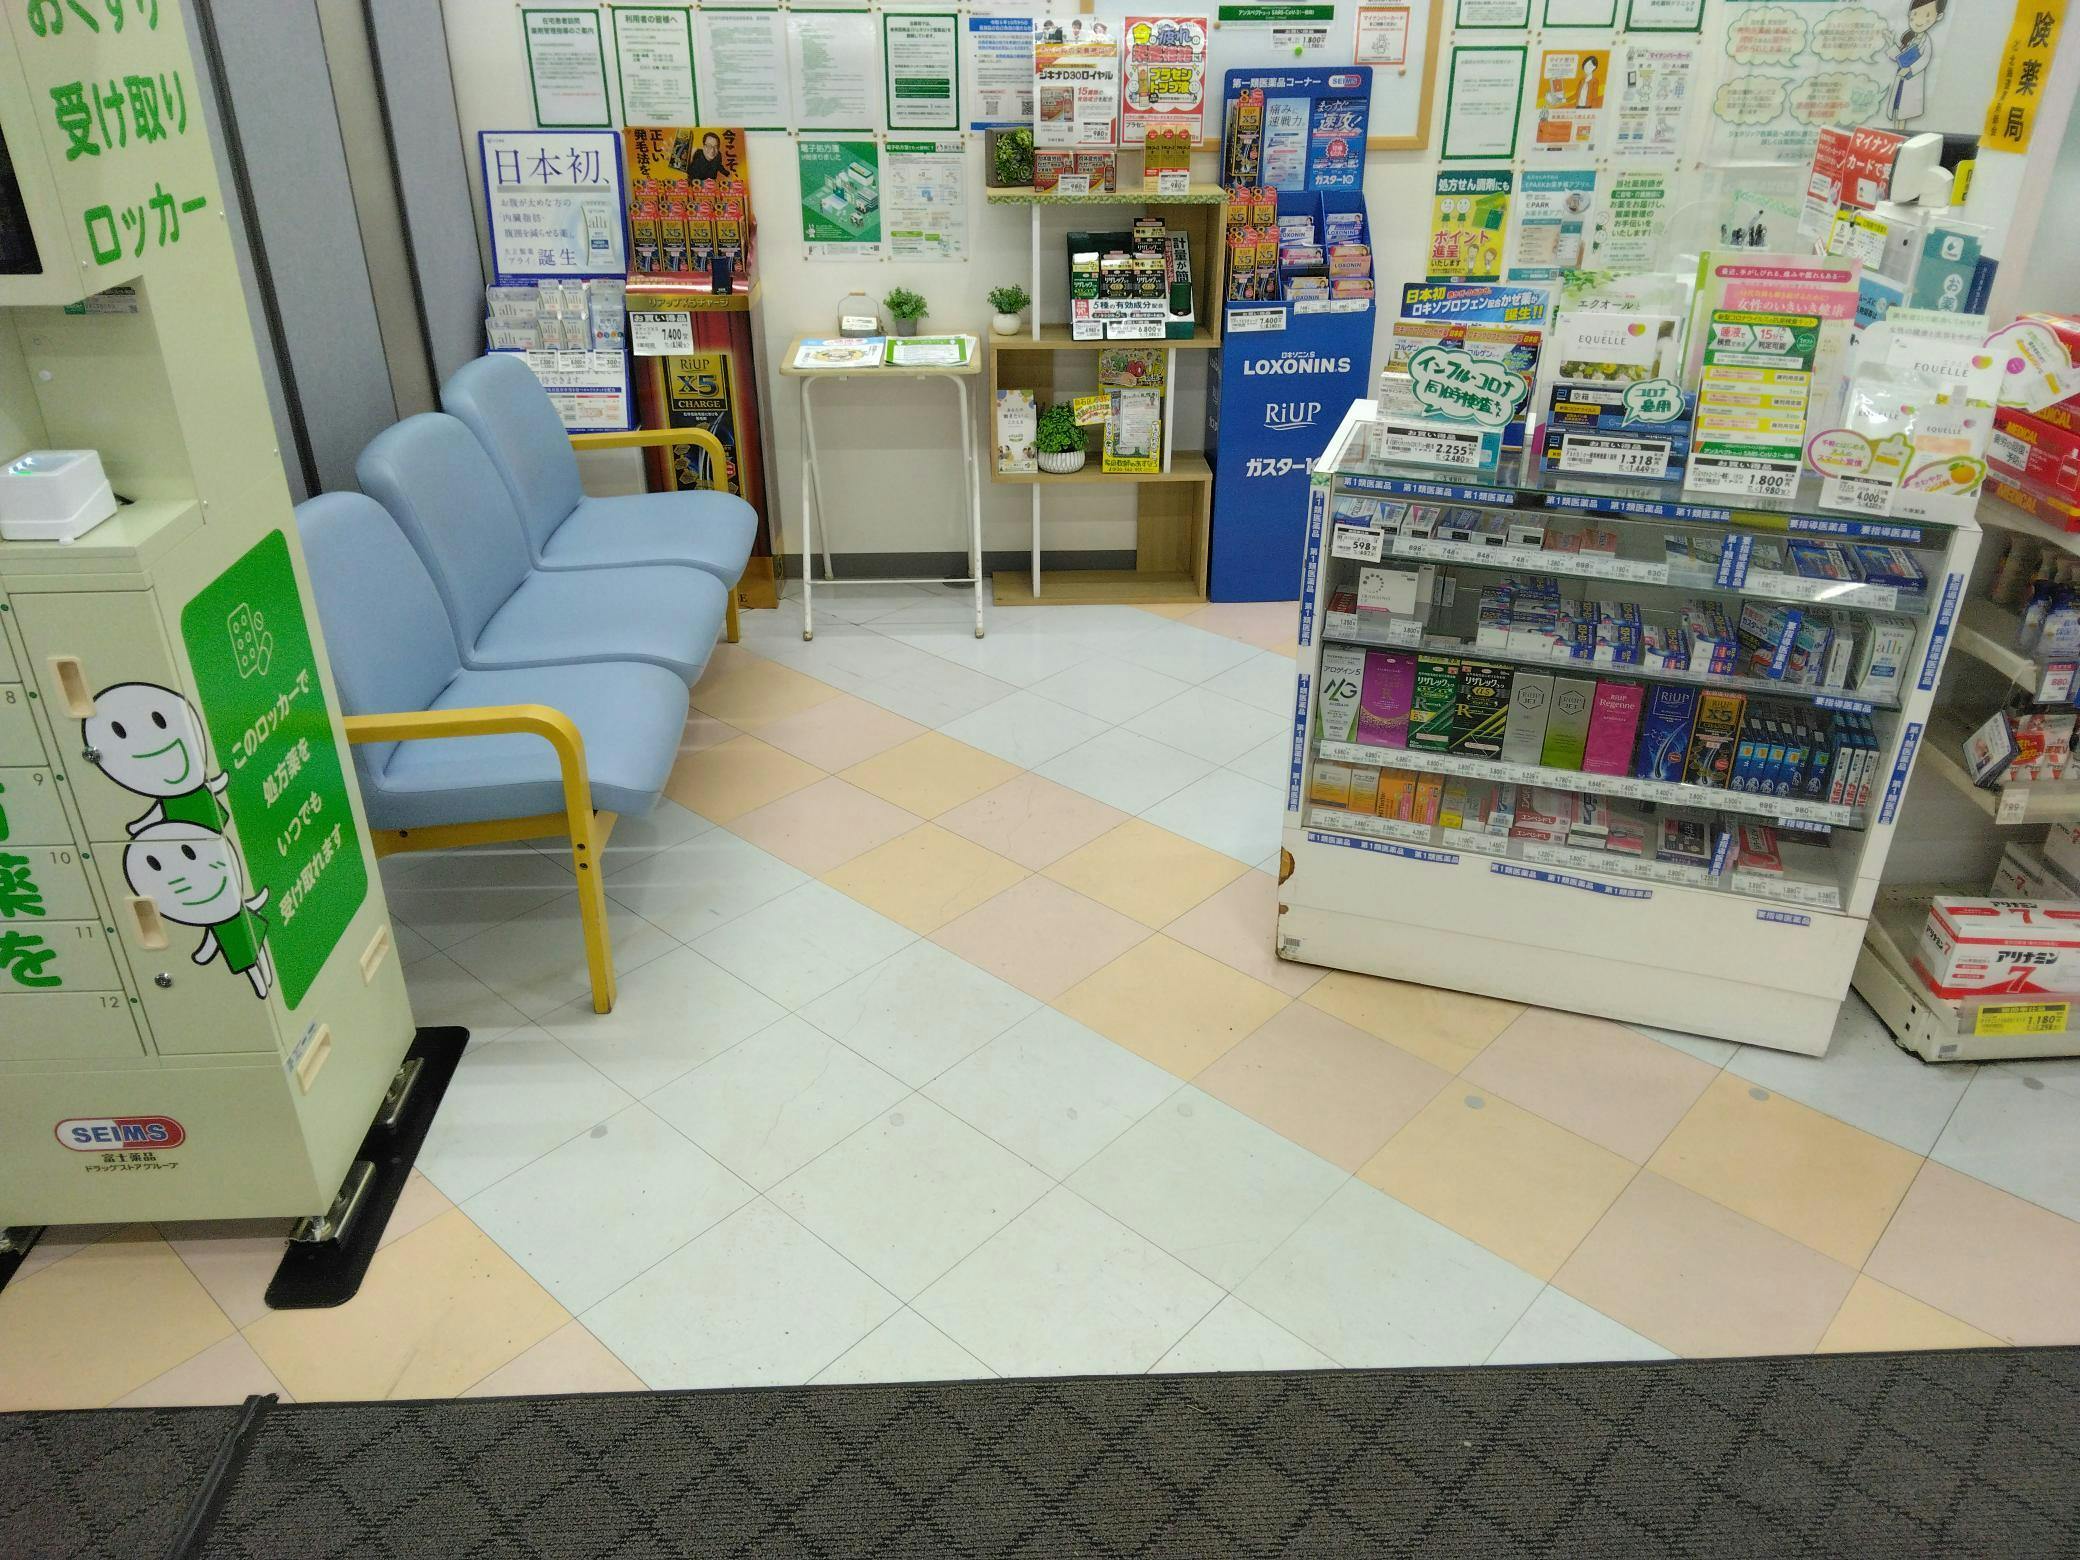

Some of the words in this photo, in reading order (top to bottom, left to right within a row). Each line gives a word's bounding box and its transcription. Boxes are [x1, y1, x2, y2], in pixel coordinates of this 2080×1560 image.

[1232, 77, 1321, 88] 第一類医薬品コーナー
[50, 71, 187, 161] 受け取り
[649, 129, 665, 163] 正しい
[494, 147, 610, 185] 日本初、
[1438, 177, 1510, 192] 処方せん調剤にも
[84, 182, 207, 265] ロッカー
[1614, 219, 1651, 227] お手伝いを
[637, 228, 653, 239] X5
[665, 228, 682, 239] X5
[692, 228, 709, 239] X5
[720, 228, 737, 239] X5
[1434, 229, 1489, 245] ポイント
[538, 247, 577, 266] 誕生
[1432, 244, 1459, 259] 進呈
[1431, 259, 1461, 267] いたします
[1405, 287, 1447, 304] 日本初
[1578, 334, 1628, 346] EQUELLE
[680, 359, 711, 370] RiUP
[677, 374, 720, 397] X5
[1635, 388, 1669, 397] コロナ
[678, 400, 721, 408] CHARGE
[1265, 402, 1322, 424] RiUP
[1926, 425, 1962, 435] EQUELLE
[2005, 421, 2038, 445] MEDICAL
[1343, 477, 1393, 491] 第1類医薬品
[1402, 482, 1453, 498] 第1類医薬品
[1463, 490, 1515, 505] 第1類医薬品
[1545, 492, 1598, 509] 第1類医薬品
[1610, 501, 1663, 515] 第1類医薬品
[1675, 507, 1731, 521] 第1類医薬品
[1352, 541, 1371, 551] 598
[6, 690, 17, 704] 8
[1661, 691, 1691, 702] RiUP
[1599, 698, 1636, 710] Regenne
[231, 668, 311, 770] このロッカーで
[32, 772, 44, 787] 9
[262, 736, 312, 809] 処方薬を
[277, 790, 323, 858] いつでも
[50, 851, 71, 865] 10
[279, 822, 343, 926] 受け取れます
[75, 926, 94, 939] 11
[1996, 950, 2059, 965] アリナミン
[2006, 965, 2038, 994] 7
[99, 996, 121, 1009] 12
[71, 1123, 170, 1144] SEIMS
[102, 1152, 157, 1163] 富士薬品
[85, 1162, 179, 1172] ドラッグストアグループ
